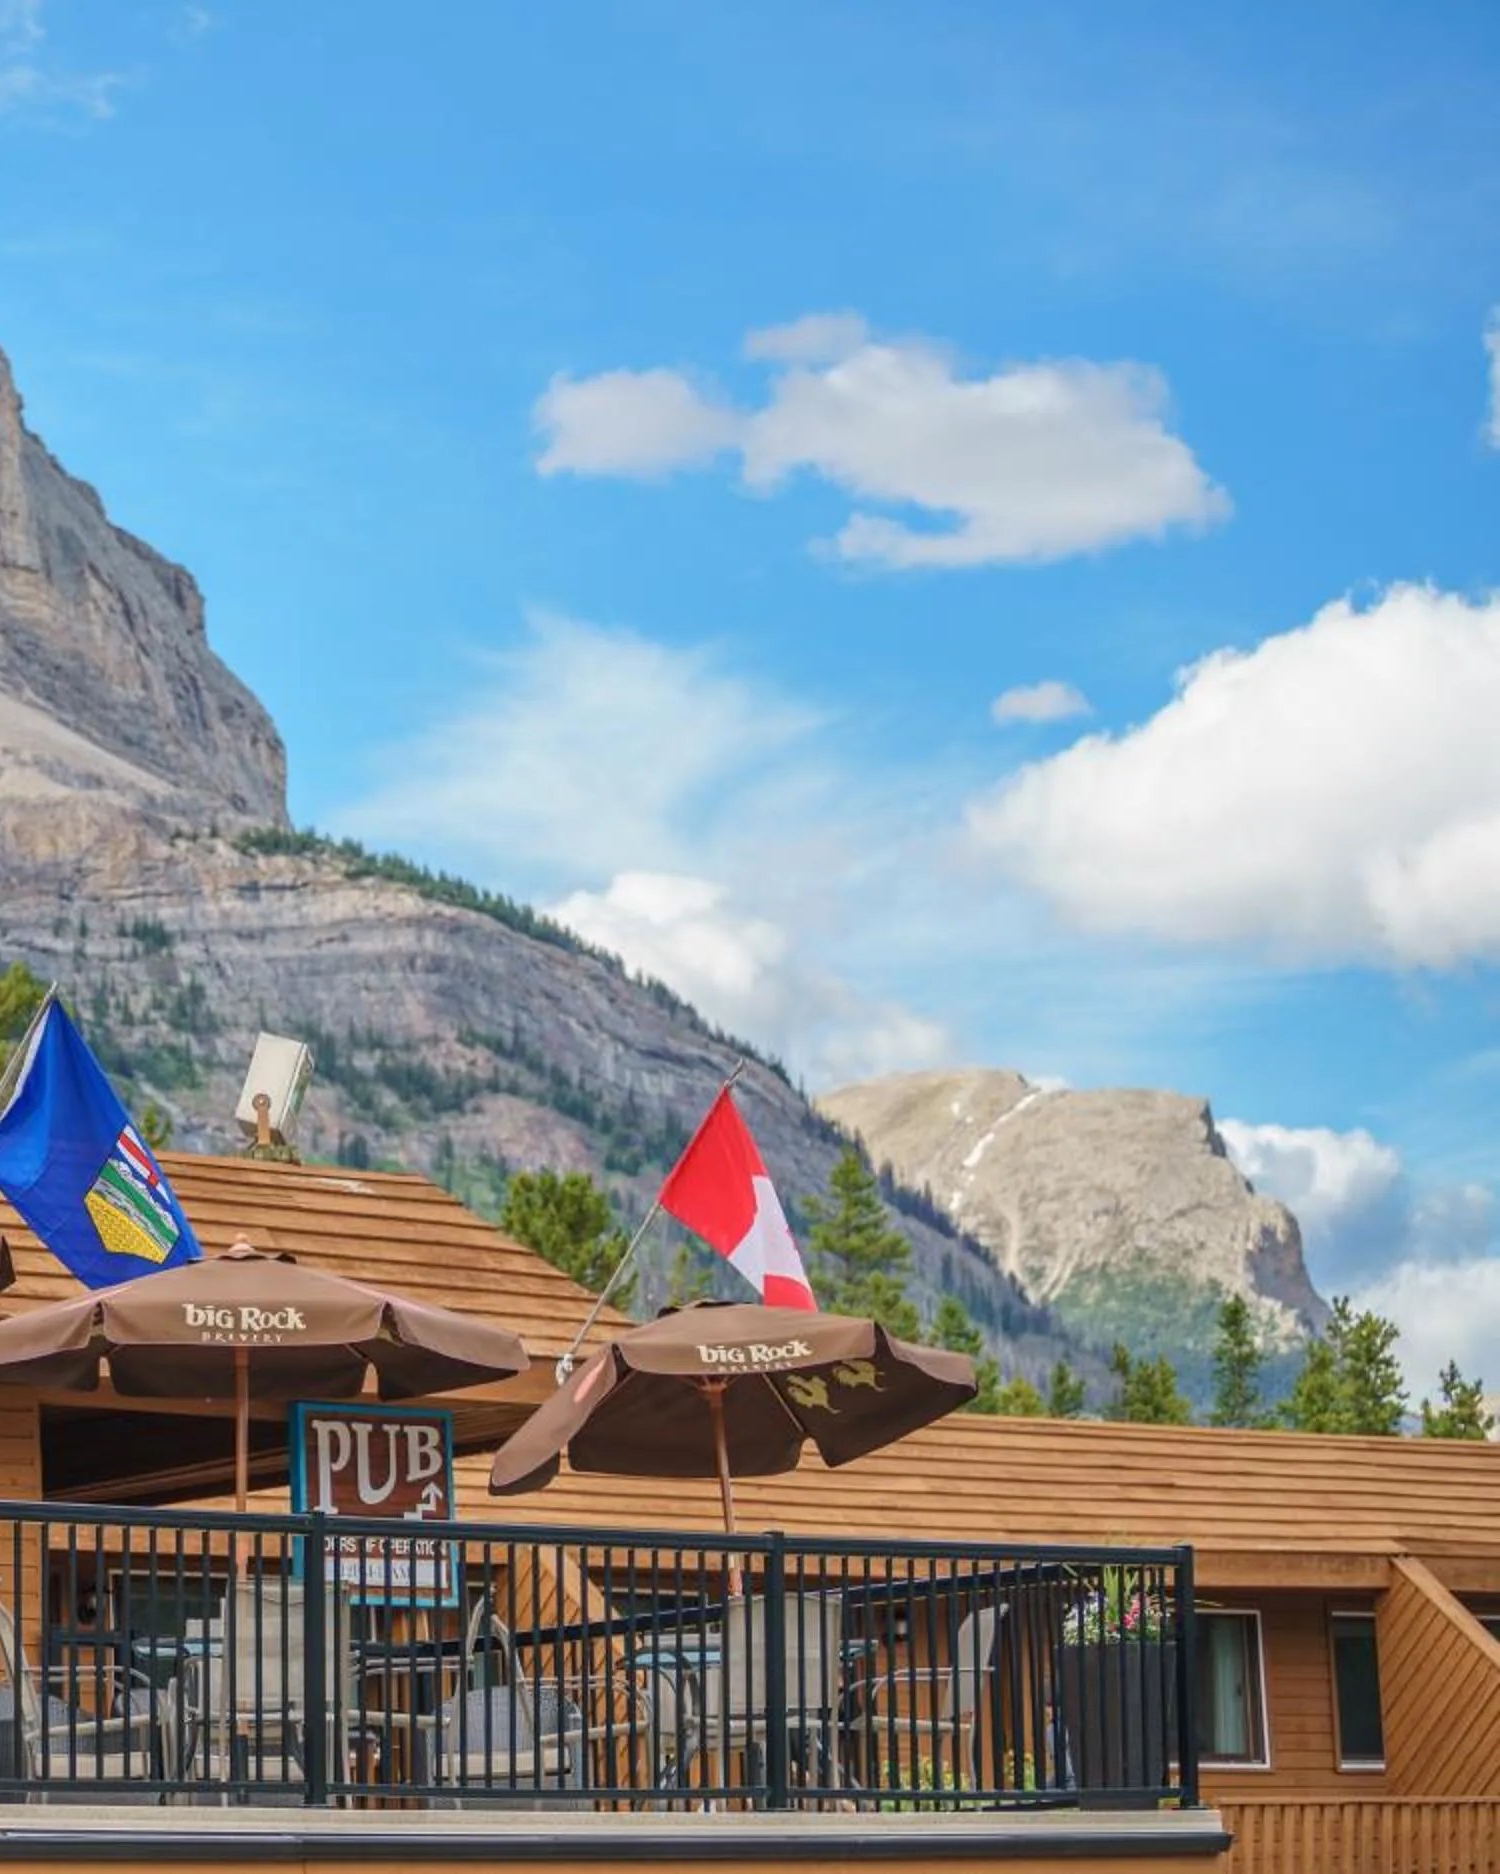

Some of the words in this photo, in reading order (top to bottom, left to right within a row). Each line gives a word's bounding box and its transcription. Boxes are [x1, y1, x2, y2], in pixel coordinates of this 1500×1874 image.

[238, 1307, 307, 1332] Rock
[746, 1340, 812, 1363] Rock
[312, 1419, 443, 1515] PUB
